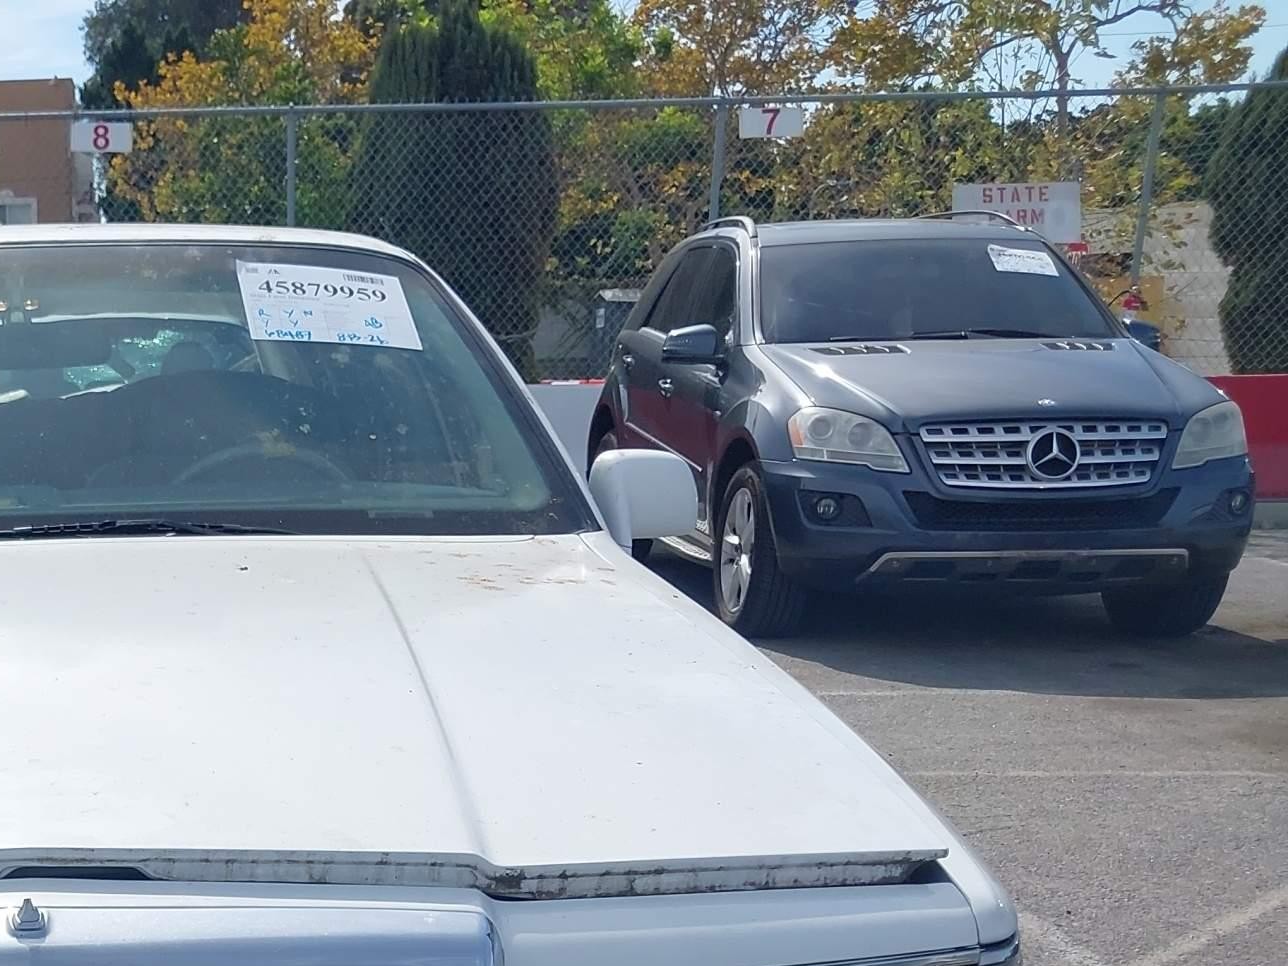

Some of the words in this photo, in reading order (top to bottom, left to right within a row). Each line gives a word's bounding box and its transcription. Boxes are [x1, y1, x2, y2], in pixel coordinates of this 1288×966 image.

[761, 108, 782, 136] 7
[93, 124, 110, 151] 8
[982, 185, 1049, 204] STATE
[257, 279, 387, 303] 45879959
